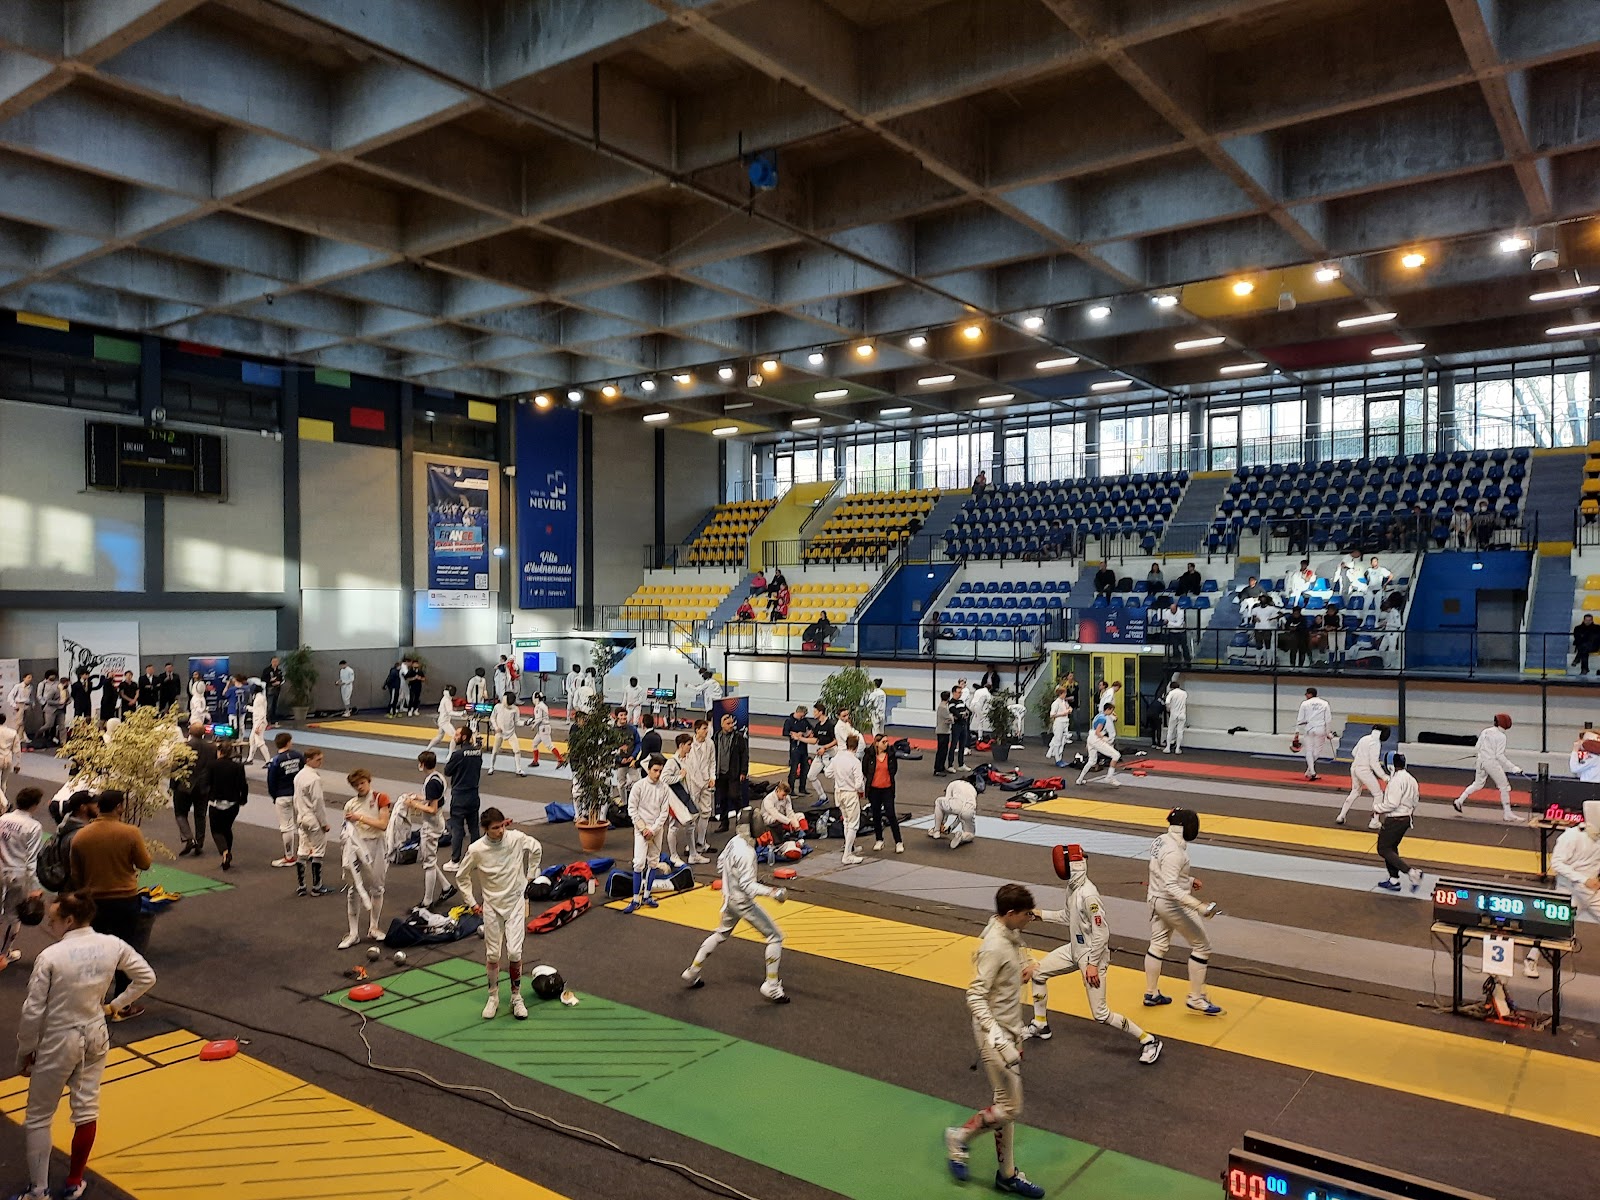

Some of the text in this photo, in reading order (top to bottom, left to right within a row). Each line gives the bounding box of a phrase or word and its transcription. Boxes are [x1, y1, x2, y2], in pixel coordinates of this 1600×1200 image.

[529, 498, 567, 511] NEVERS
[439, 530, 474, 542] FRANCE
[539, 550, 558, 564] Ville
[1435, 889, 1457, 905] 00
[1546, 904, 1570, 920] 00
[1491, 945, 1505, 962] 3
[1267, 1176, 1287, 1195] 00
